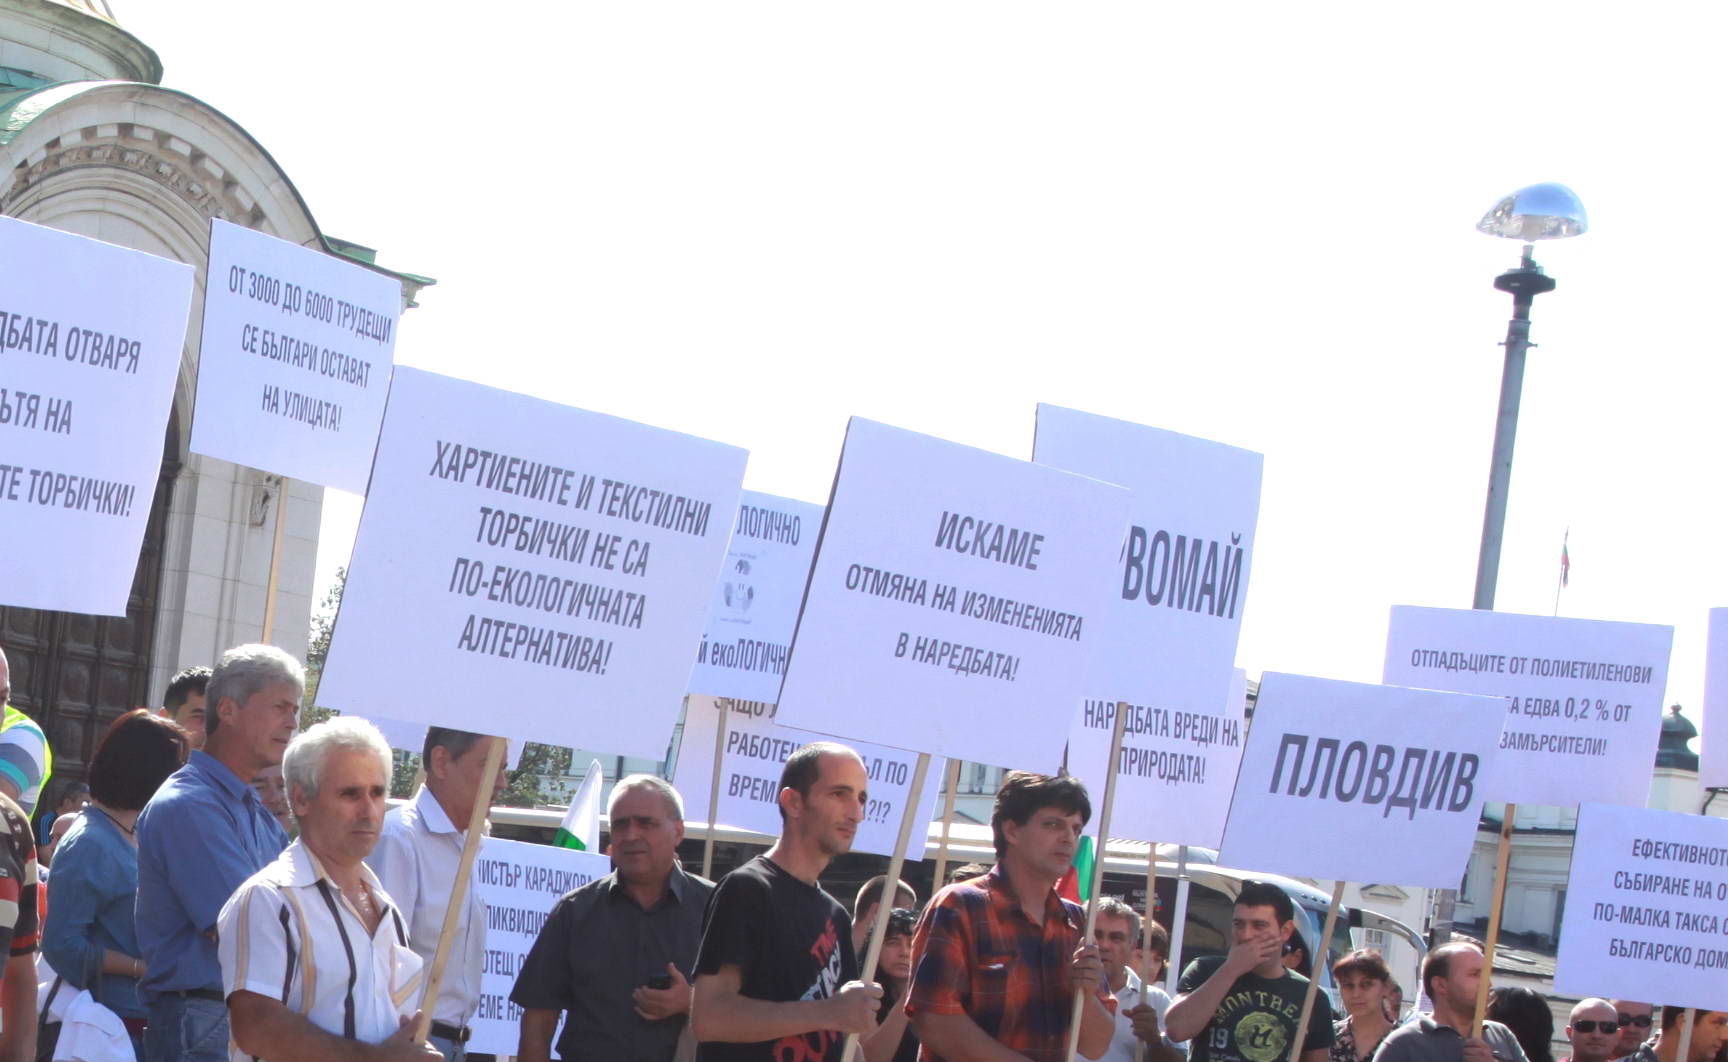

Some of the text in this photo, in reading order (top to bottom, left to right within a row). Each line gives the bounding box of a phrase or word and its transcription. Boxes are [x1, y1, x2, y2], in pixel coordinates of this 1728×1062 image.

[228, 264, 392, 346] ОТ 3000 ДО 6000 ТРУДЕЩИ
[64, 326, 142, 375] ОТВАРЯ
[241, 323, 372, 389] СЕ БЪЛГАРИ ОСТАВАТ
[43, 397, 73, 435] НА
[261, 383, 342, 432] НА УЛИЦАТА!
[27, 468, 136, 518] ТОРБИЧКИ!
[429, 439, 712, 537] ХАРТИЕНИТЕ И ТЕКСТИЛНИ
[476, 506, 651, 578] ТОРБИЧКИ НЕ СА
[934, 510, 1045, 571] ИСКАМЕ
[448, 556, 649, 630] ПО-ЕКОЛОГИЧНАТА
[1119, 525, 1244, 620] ВОМАЙ
[845, 563, 1083, 642] ОТМЯНА НА ИЗМЕНЕНИЯТА
[457, 614, 613, 676] АЛТЕРНАТИВА!
[894, 631, 1020, 682] В НАРЕДБАТА!
[1411, 648, 1653, 684] ОТПАДЪЦИТЕ ОТ ПОЛИЕТИЛЕНОВИ
[1084, 699, 1239, 748] НАРДБАТА ВРЕДИ НА
[1523, 697, 1560, 720] ЕДВА
[1564, 696, 1591, 722] 0,2
[1595, 698, 1610, 721] %
[1613, 703, 1632, 722] ОТ
[1118, 746, 1206, 786] ПРИРОДАТА!
[1499, 731, 1607, 756] ЗАМЪРСИТЕЛИ!
[728, 773, 779, 804] ВРЕМ
[885, 760, 908, 786] ПО
[1269, 733, 1480, 821] ПЛОВДИВ
[478, 859, 522, 889] ИСТЪР
[1613, 870, 1691, 897] СЪБИРАНЕ
[1693, 879, 1713, 900] НА
[1593, 902, 1670, 929] ПО-МАЛКА
[1675, 911, 1718, 935] ТАКСА
[1608, 938, 1693, 966] БЪЛГАРСКО
